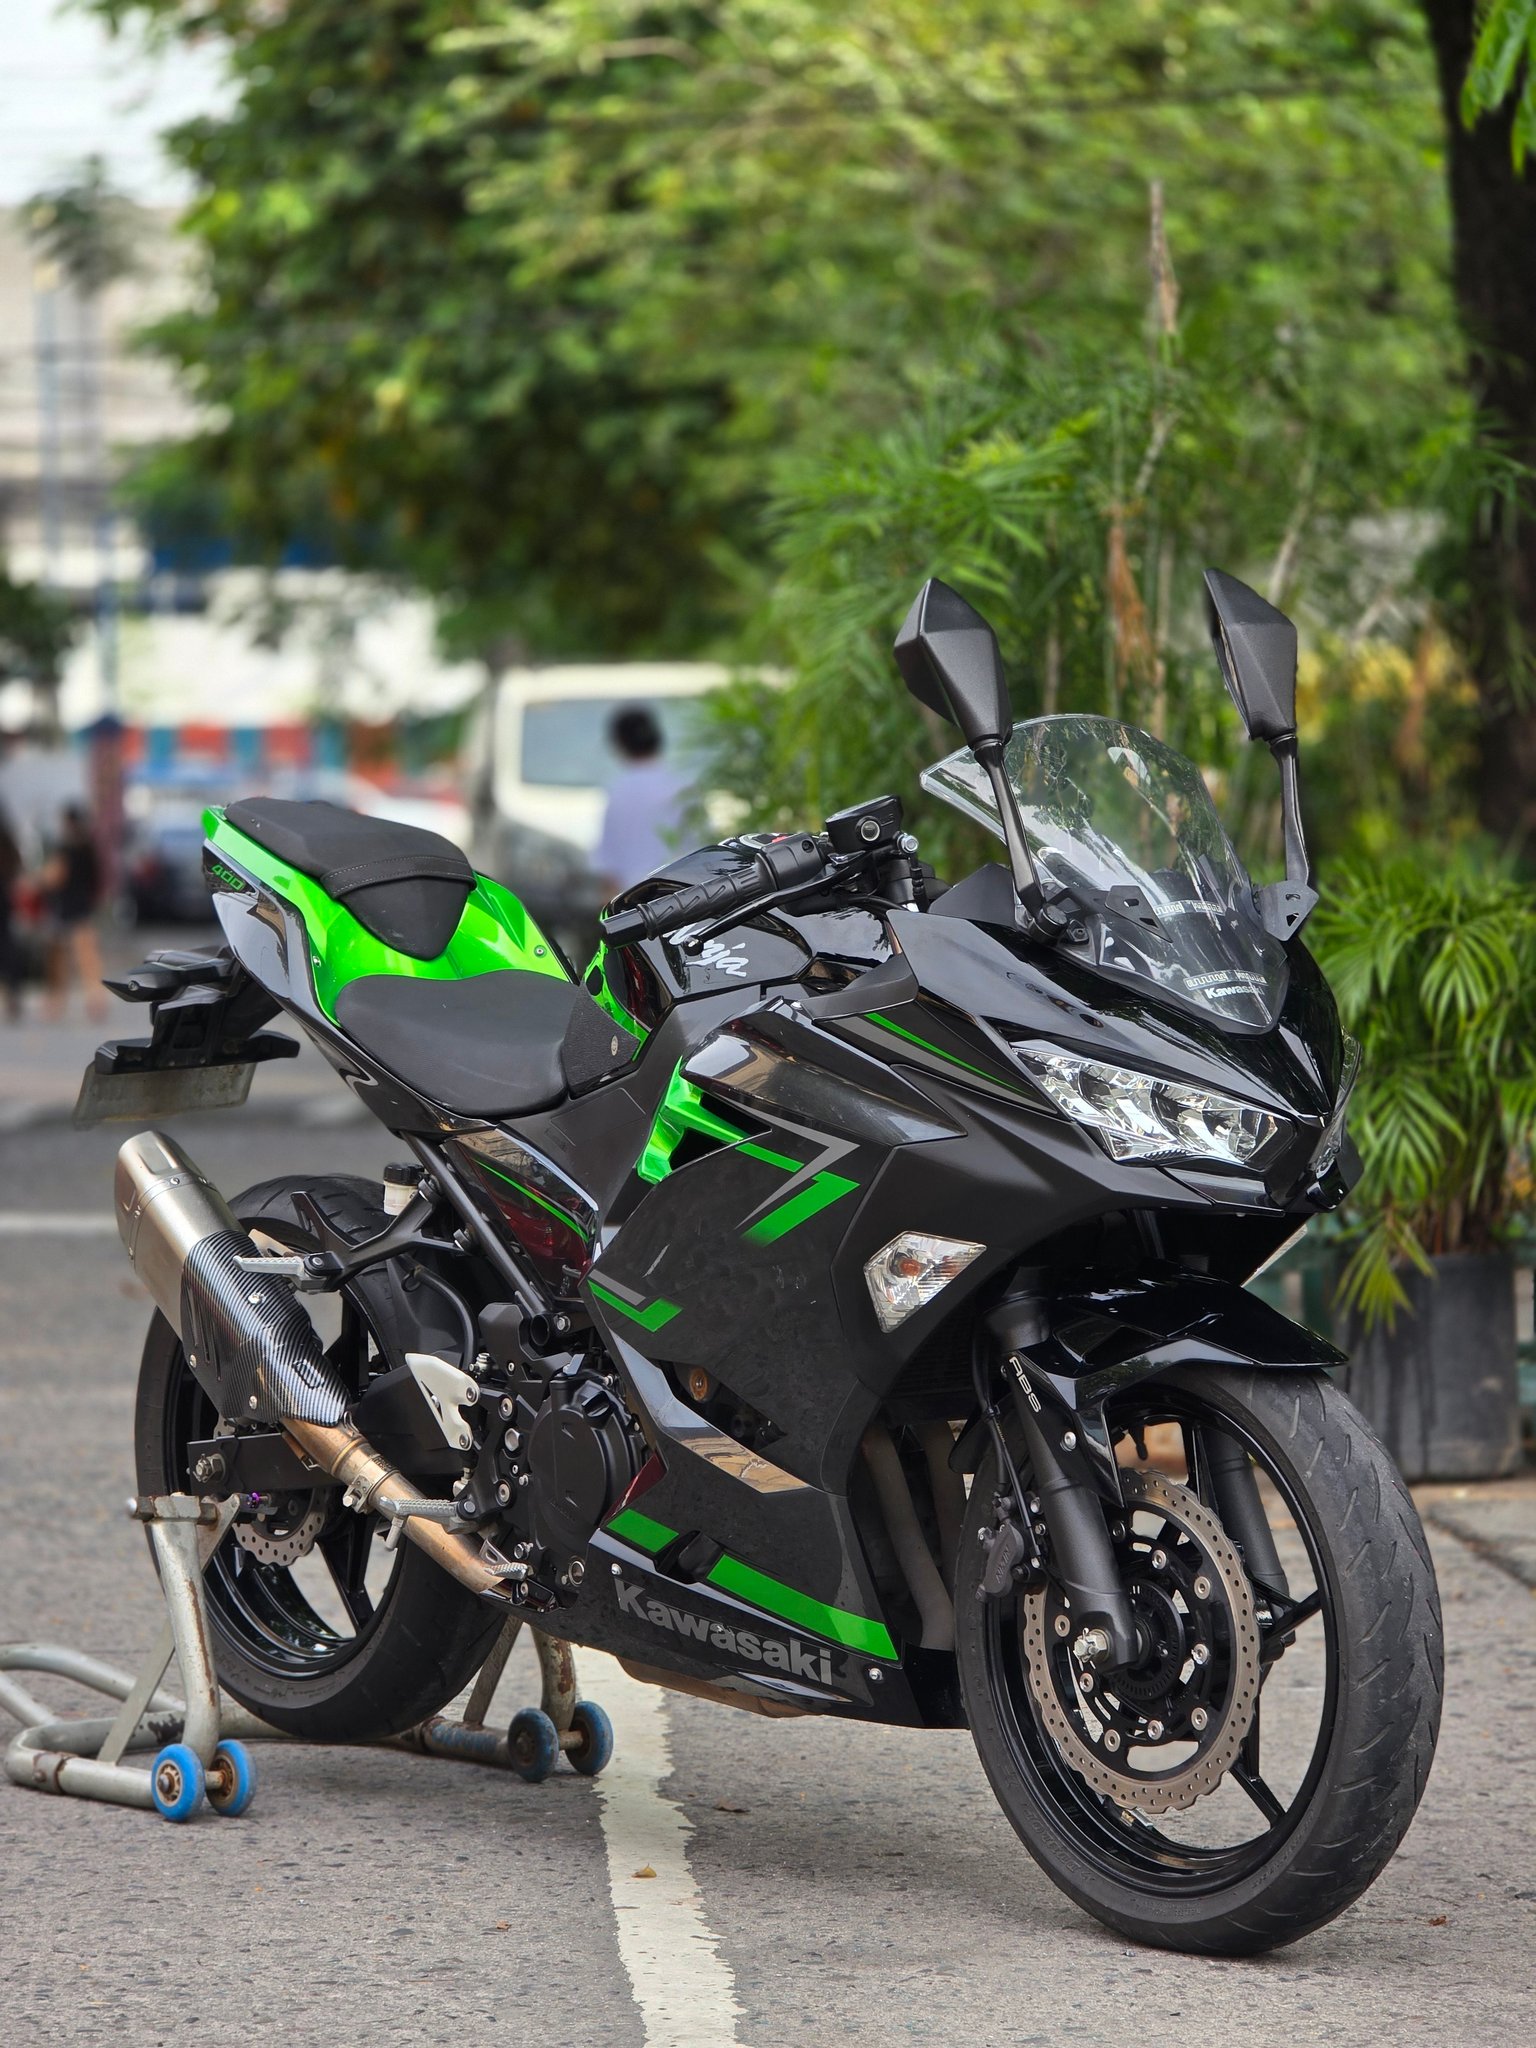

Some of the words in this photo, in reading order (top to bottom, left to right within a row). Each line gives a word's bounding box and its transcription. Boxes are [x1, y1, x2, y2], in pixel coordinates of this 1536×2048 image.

[211, 864, 245, 891] 400
[662, 922, 749, 978] Nnja
[1204, 985, 1266, 999] Kawasaki
[1009, 1356, 1042, 1413] ABS
[614, 1578, 833, 1686] Kawasaki
